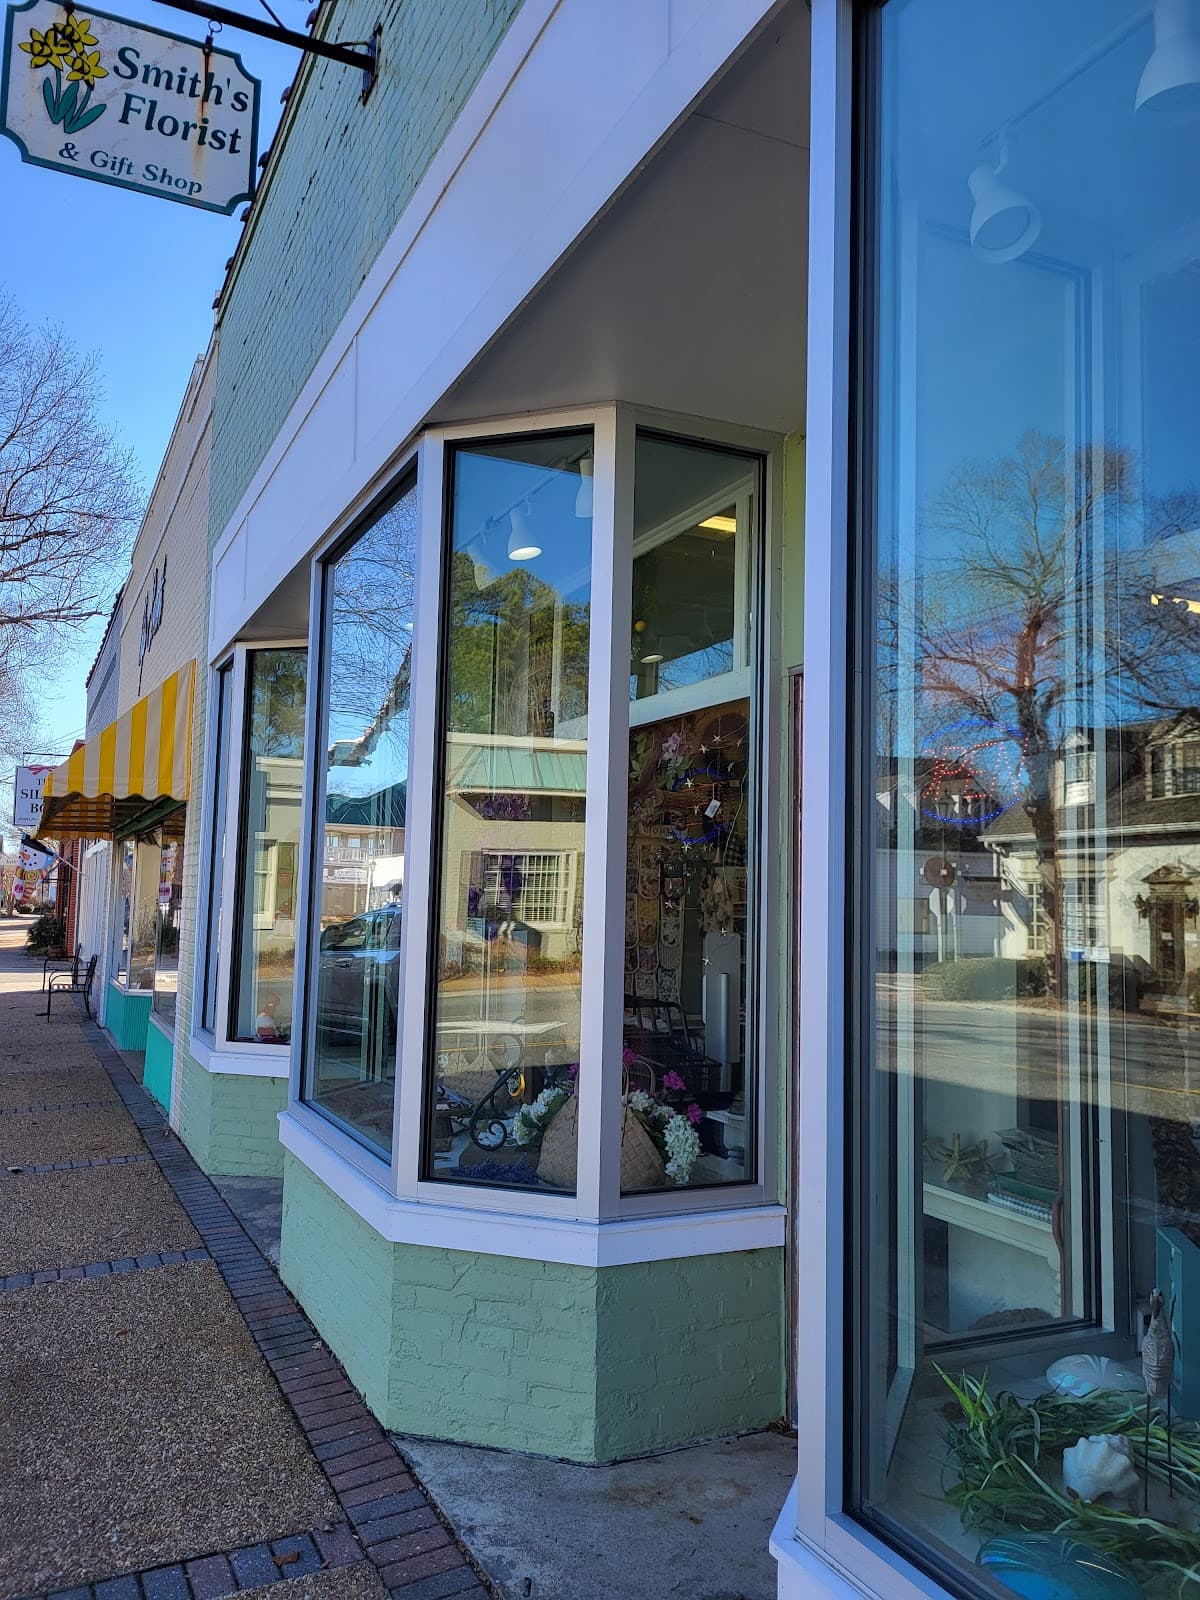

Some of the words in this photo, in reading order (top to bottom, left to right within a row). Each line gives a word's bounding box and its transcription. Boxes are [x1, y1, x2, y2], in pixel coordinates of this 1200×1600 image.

[113, 46, 249, 112] Smith's
[118, 92, 242, 155] Florist
[58, 142, 79, 161] &
[90, 150, 135, 176] Gift
[142, 164, 203, 196] Shop
